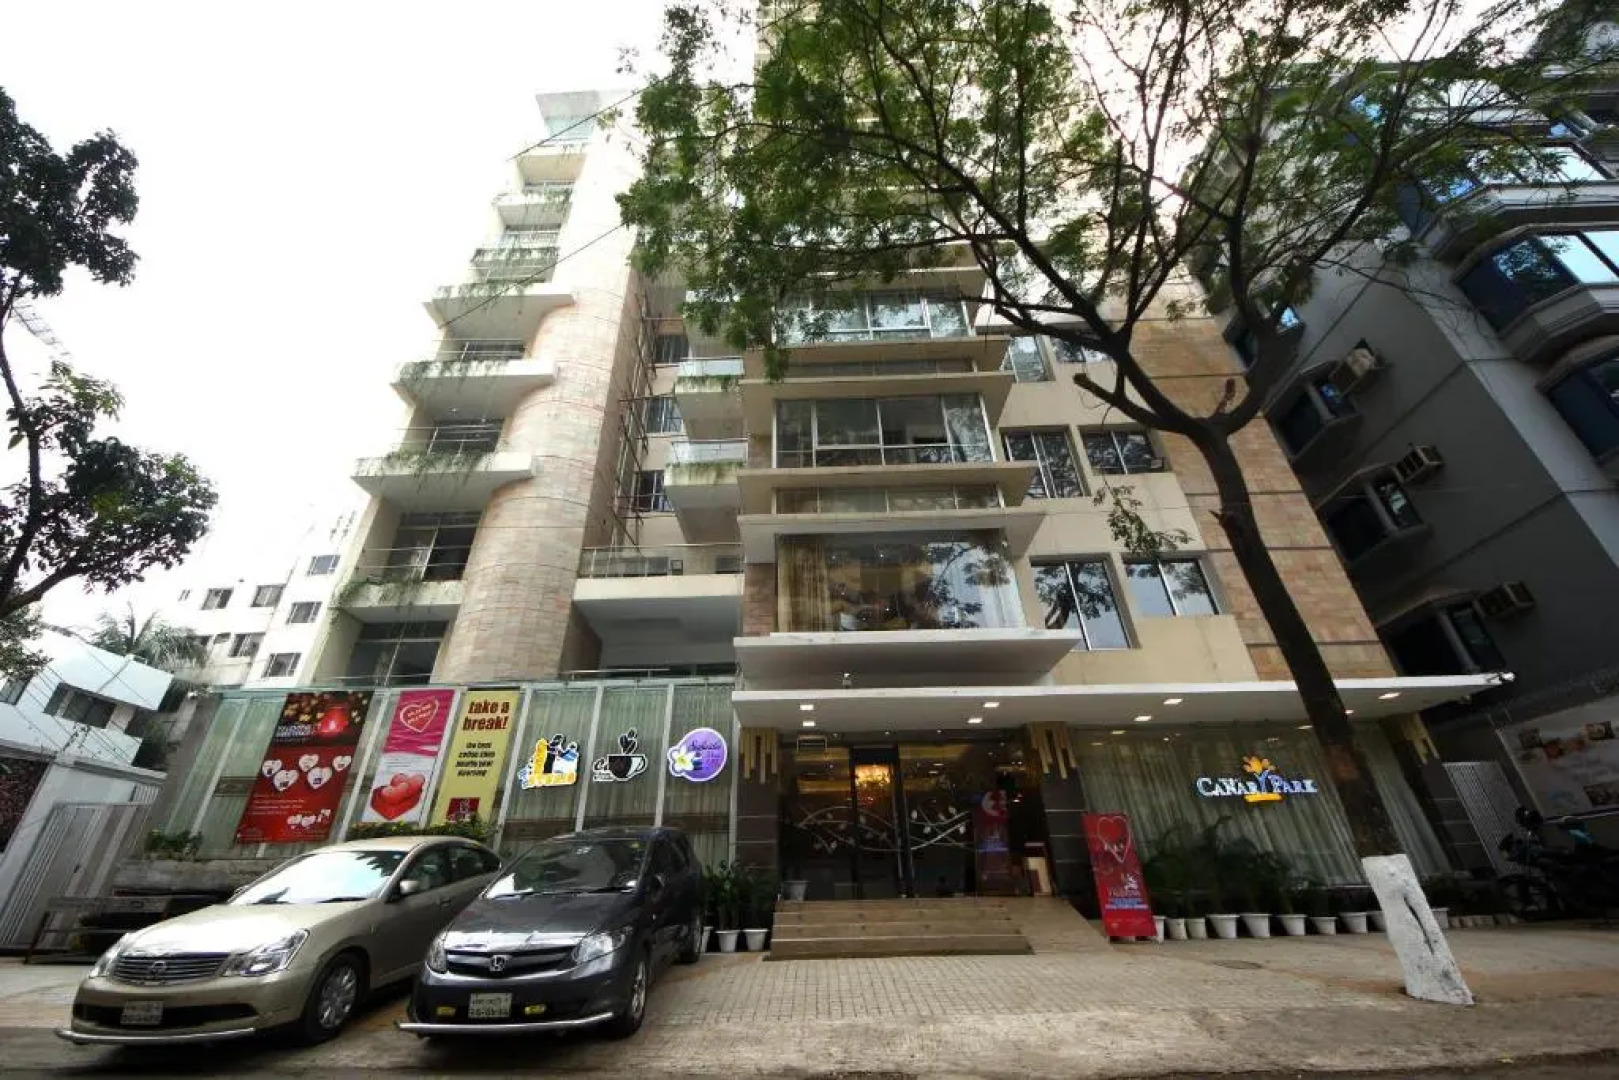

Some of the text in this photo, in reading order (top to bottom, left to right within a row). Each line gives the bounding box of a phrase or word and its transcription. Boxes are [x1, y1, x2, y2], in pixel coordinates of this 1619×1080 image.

[468, 700, 509, 714] take a
[462, 716, 509, 731] break!
